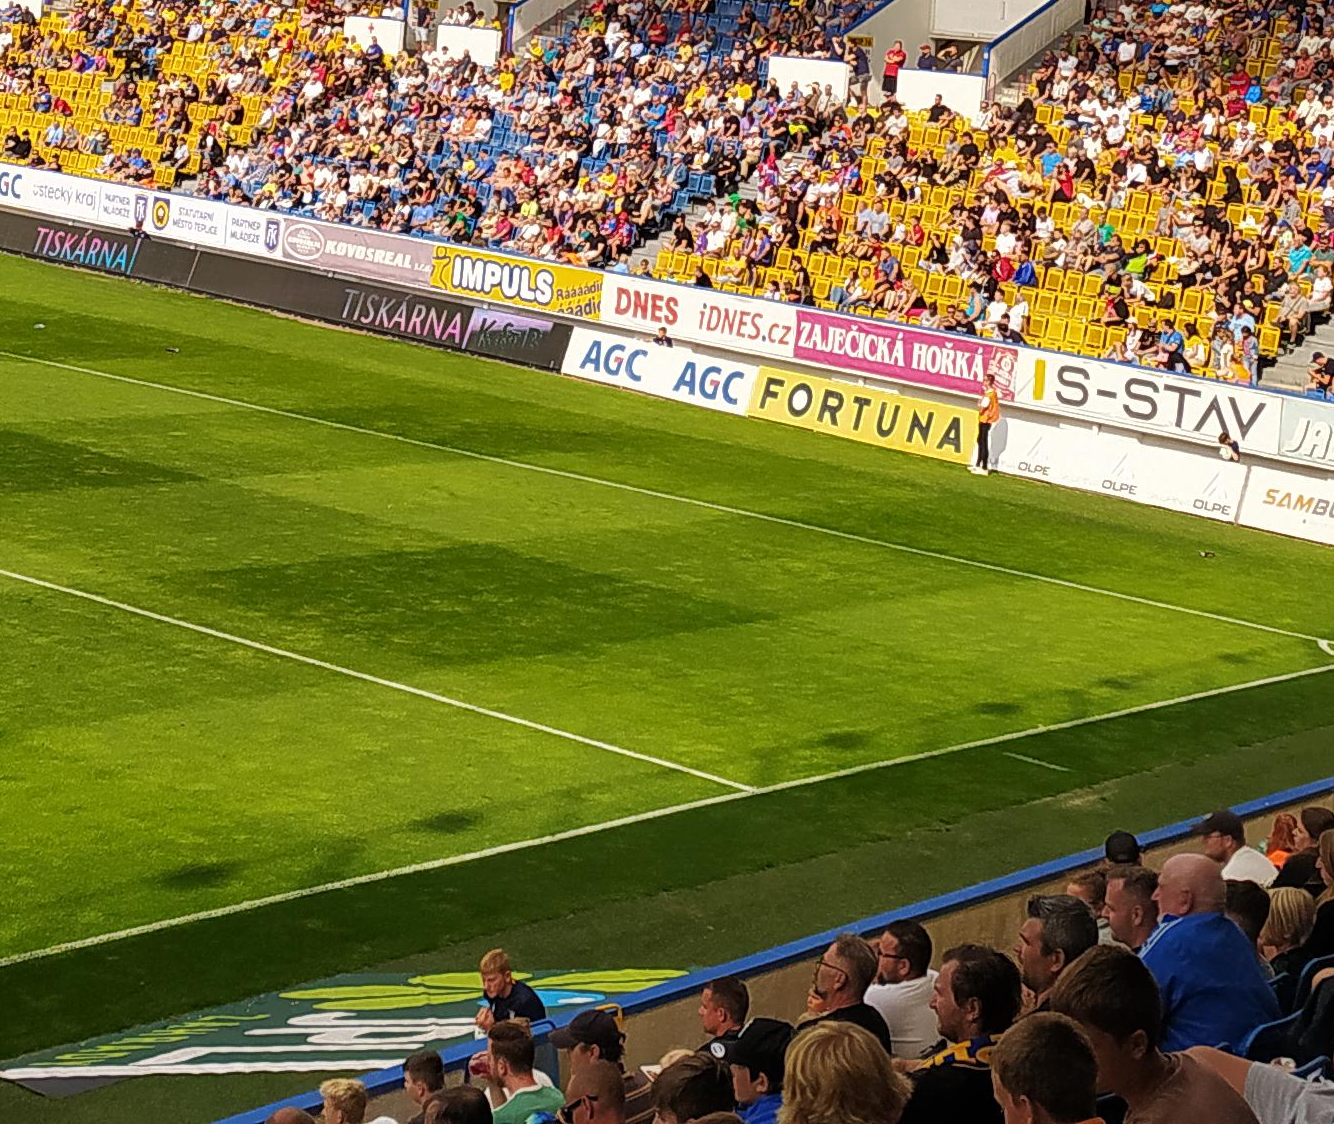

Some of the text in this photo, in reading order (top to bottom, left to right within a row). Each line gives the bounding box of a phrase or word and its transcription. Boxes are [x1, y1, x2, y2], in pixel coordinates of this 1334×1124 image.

[75, 188, 98, 211] kraj
[231, 217, 261, 231] PARTNER
[33, 227, 129, 272] TISKÁRNA
[324, 240, 412, 269] KOVOSREAL
[451, 254, 555, 306] IMPULS
[342, 287, 464, 345] TISKÁRNA
[614, 286, 680, 326] DNES
[698, 303, 793, 346] iDNES.cz
[579, 339, 649, 383] AGC
[798, 322, 906, 368] ZAJEČICKÁ
[910, 342, 985, 383] HOŘKÁ
[673, 361, 745, 405] AGC
[758, 376, 963, 454] FORTUNA
[1018, 460, 1051, 476] OLPE
[1101, 479, 1137, 495] OLPE
[1192, 498, 1231, 516] OLPE
